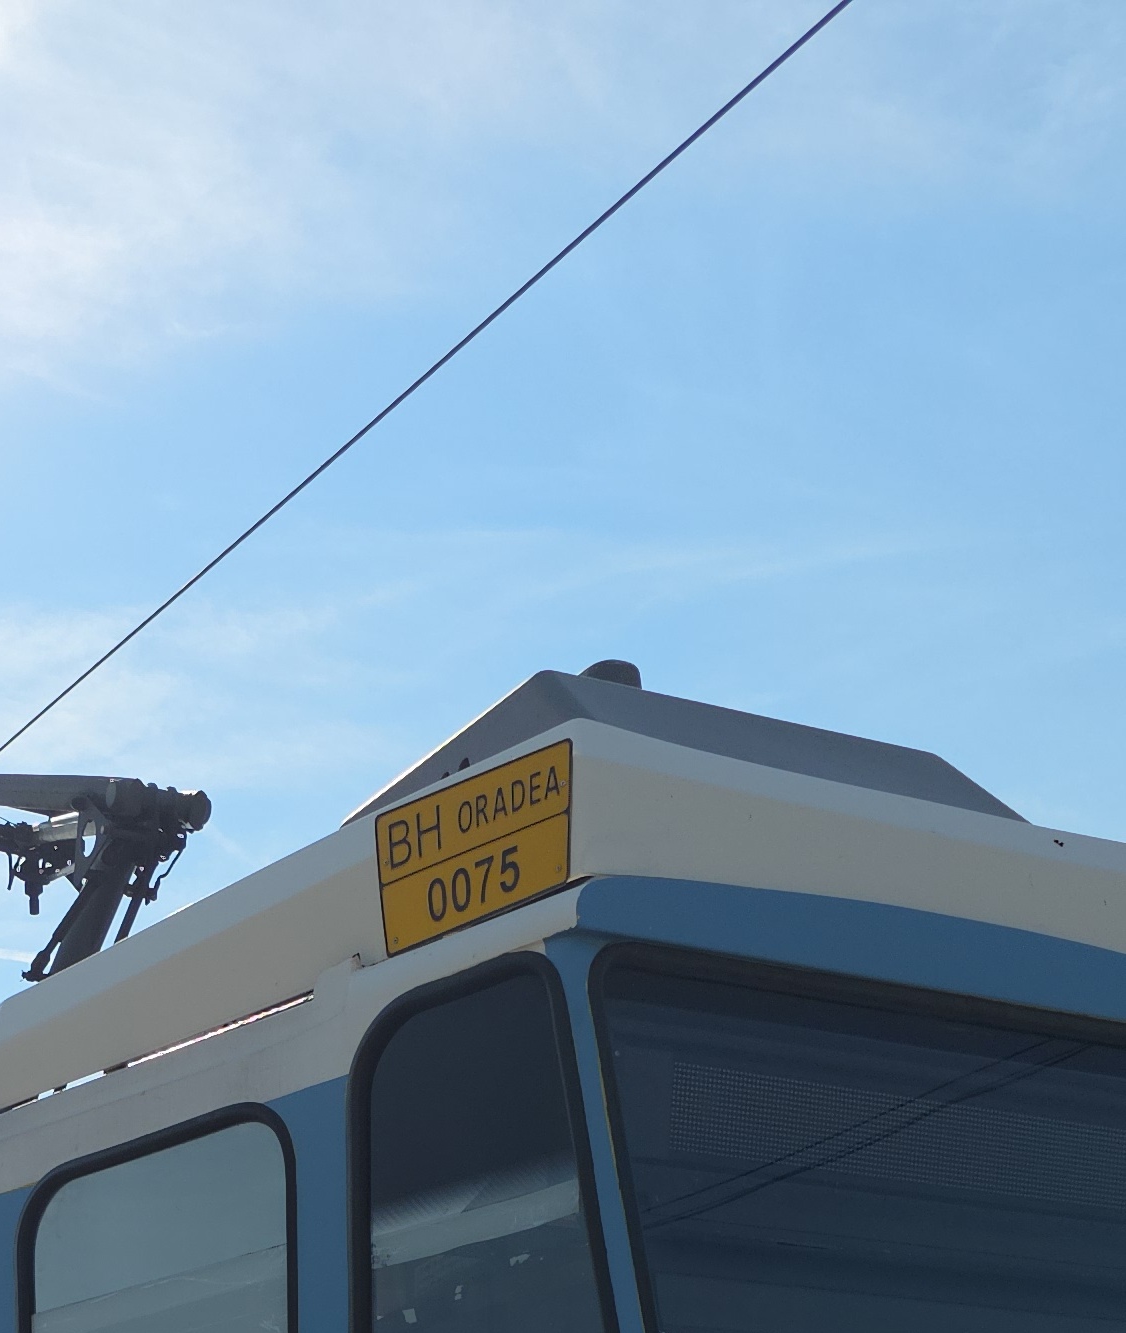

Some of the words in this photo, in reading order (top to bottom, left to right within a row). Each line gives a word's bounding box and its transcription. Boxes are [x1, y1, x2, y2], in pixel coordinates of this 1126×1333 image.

[388, 804, 442, 869] BH
[458, 765, 560, 833] ORADEA
[428, 845, 520, 922] 0075
